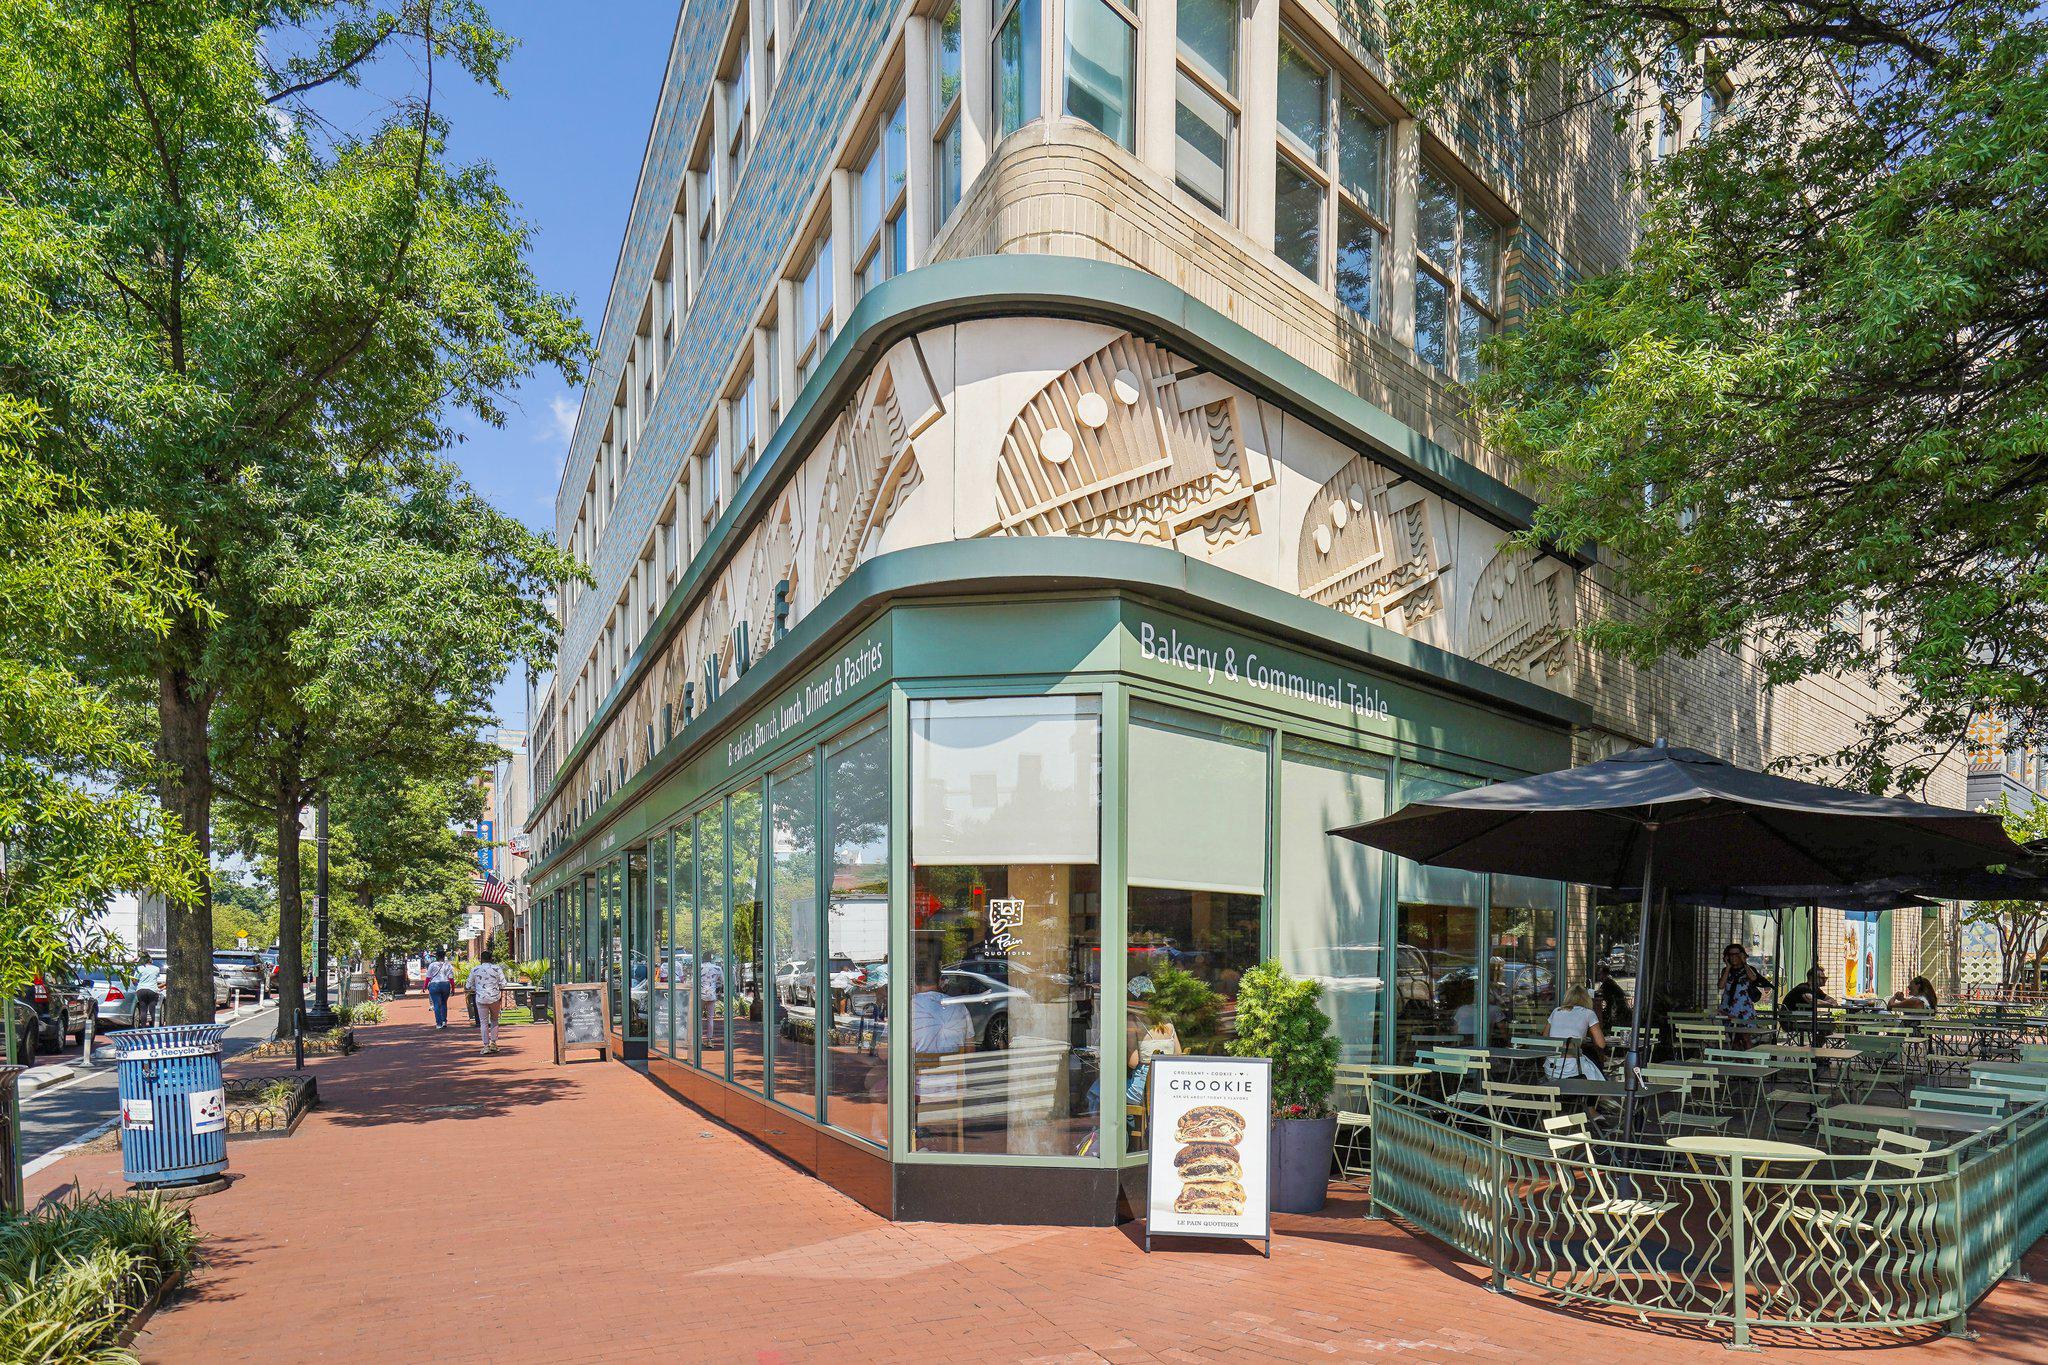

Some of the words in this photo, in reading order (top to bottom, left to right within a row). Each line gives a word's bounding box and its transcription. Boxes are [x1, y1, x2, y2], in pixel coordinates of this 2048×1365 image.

[1140, 621, 1218, 685] Bakery
[1224, 646, 1239, 683] &
[1246, 653, 1343, 710] Communal
[1346, 682, 1389, 722] Table
[755, 710, 779, 749] Brunch,
[781, 692, 804, 733] Lunch,
[805, 676, 833, 716] Dinner
[835, 664, 842, 696] &
[844, 640, 883, 690] Pastries
[990, 933, 1023, 951] Pain
[161, 1047, 196, 1057] Recycle
[1169, 1080, 1252, 1092] CROOKIE
